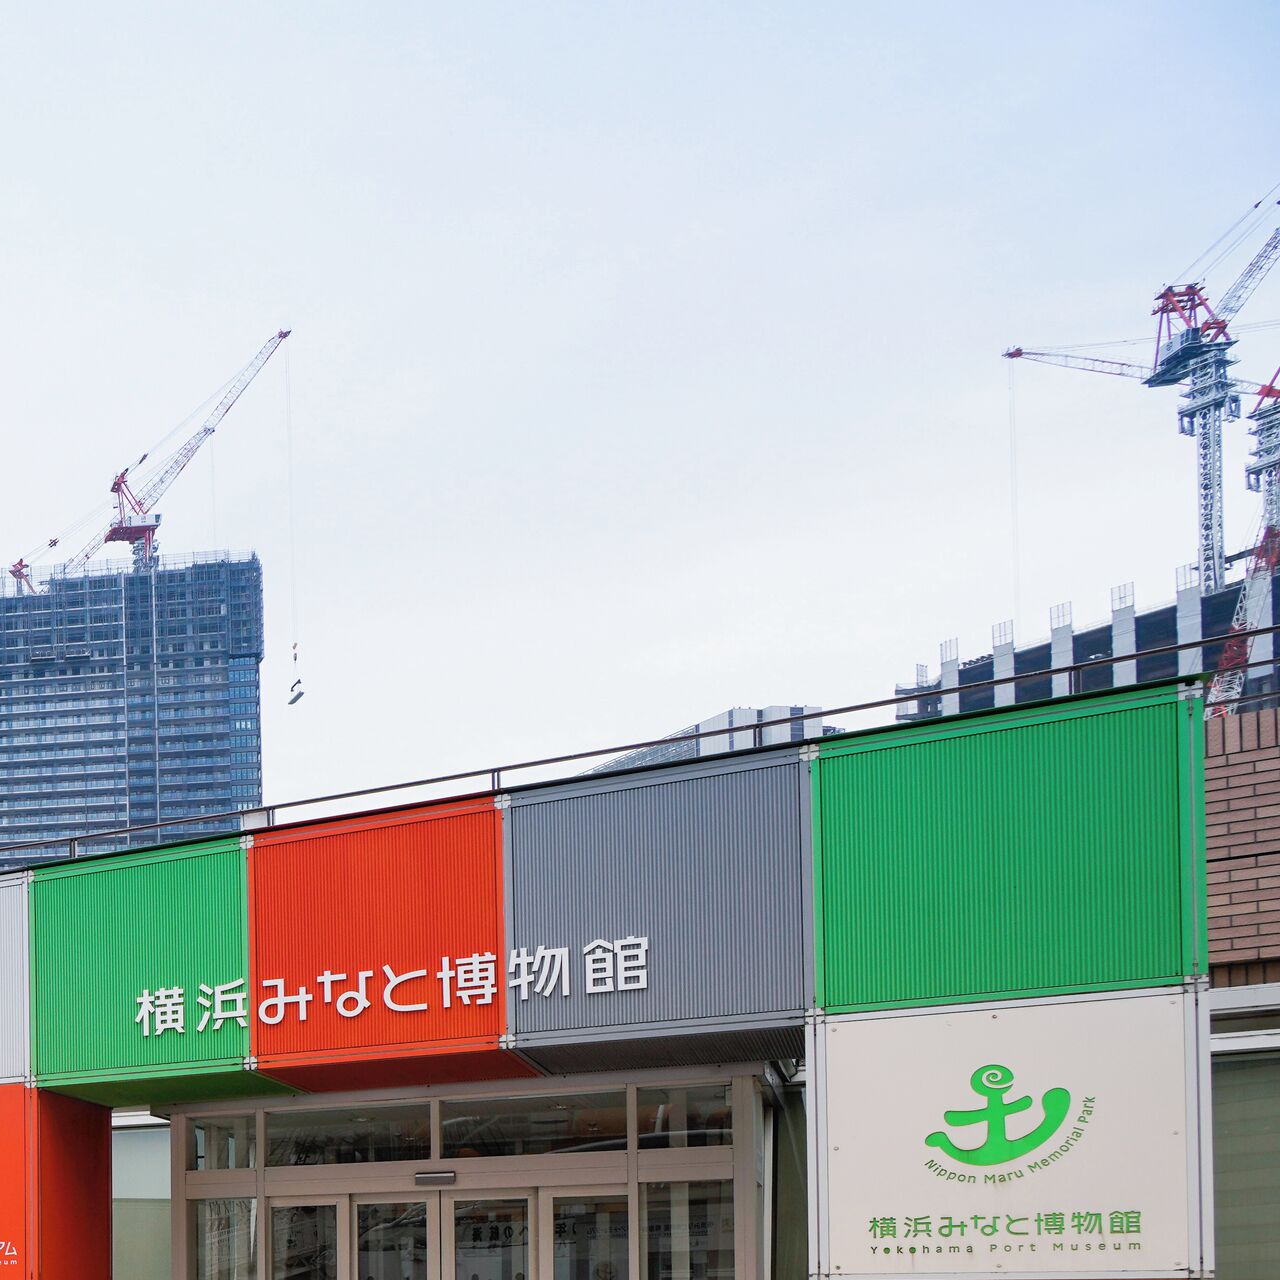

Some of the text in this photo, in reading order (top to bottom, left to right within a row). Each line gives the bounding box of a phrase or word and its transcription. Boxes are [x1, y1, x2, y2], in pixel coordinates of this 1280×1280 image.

[135, 935, 650, 1037] 横浜みなと博物館
[924, 1096, 1096, 1184] Nippon Maru Memorial Park
[868, 1210, 1141, 1239] 横浜みなと博物館
[870, 1240, 1142, 1255] Yokohama Port Museum
